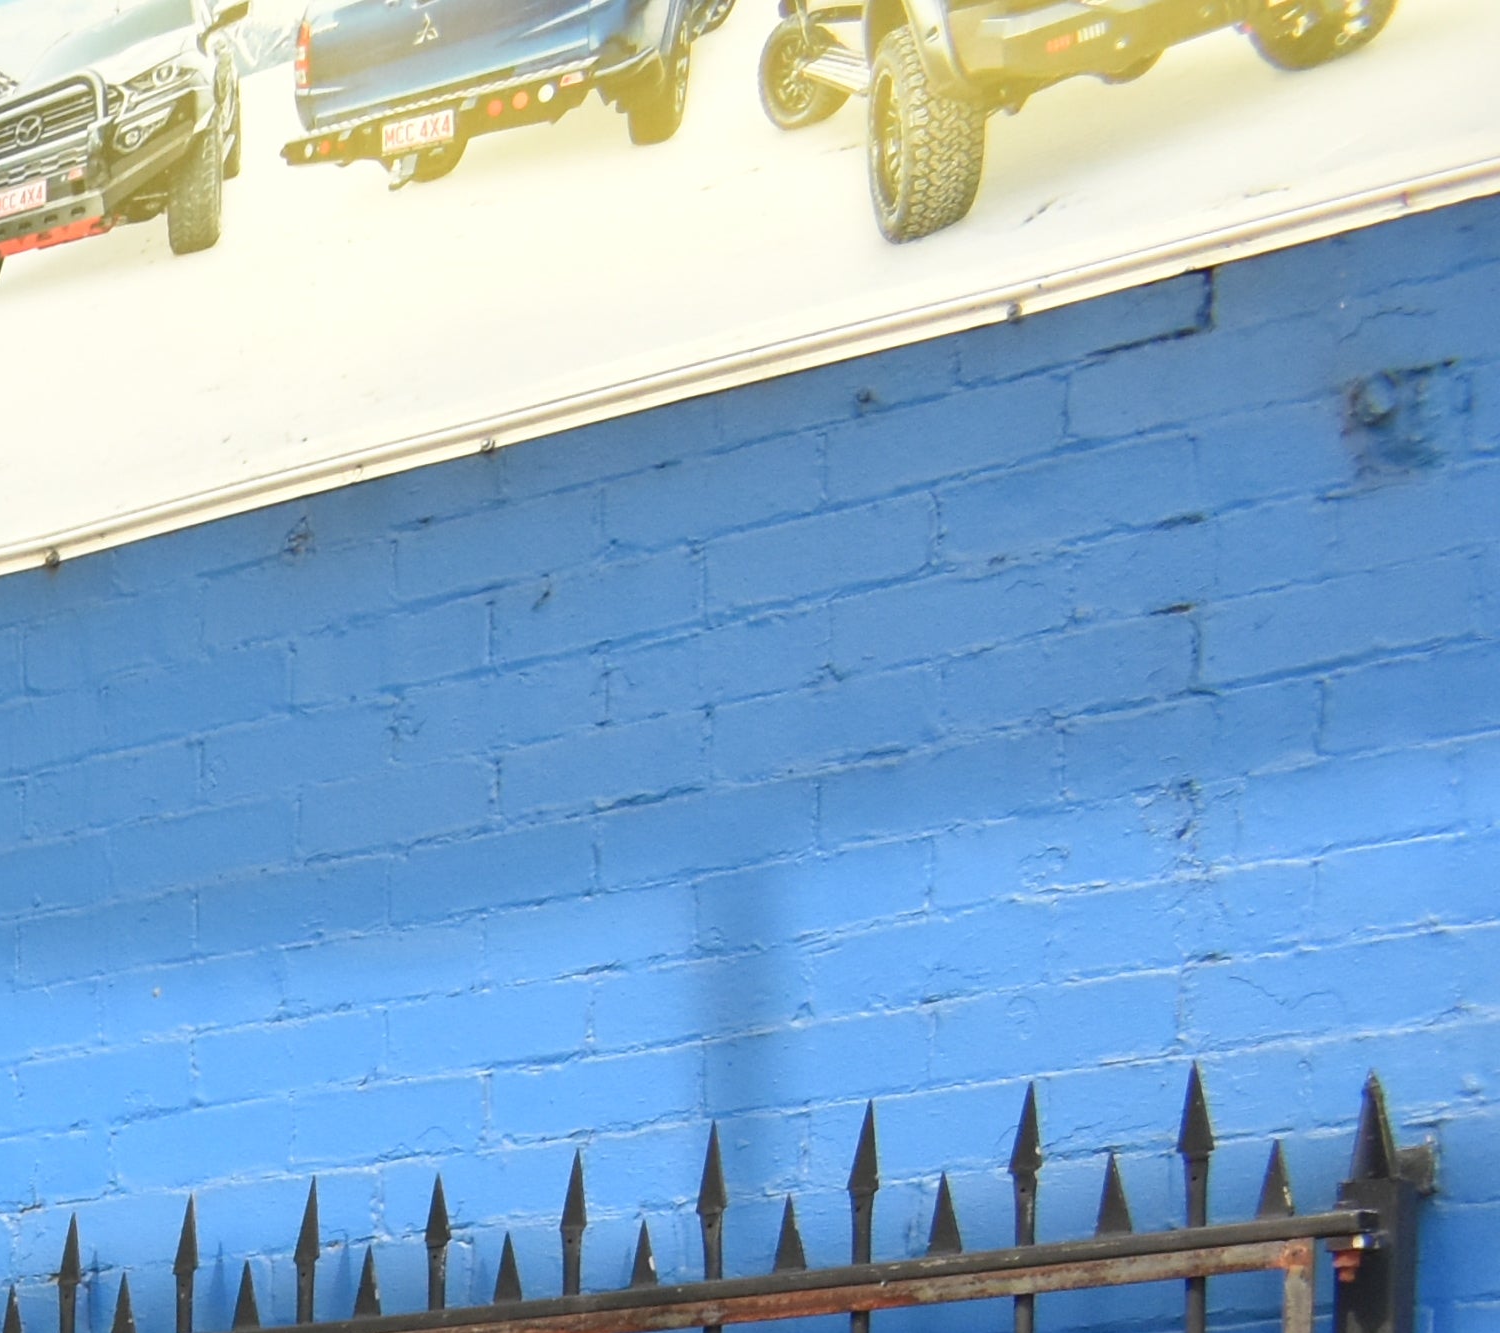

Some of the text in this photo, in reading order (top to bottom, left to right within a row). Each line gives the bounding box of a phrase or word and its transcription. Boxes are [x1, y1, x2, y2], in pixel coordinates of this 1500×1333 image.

[385, 113, 451, 147] MCC 4X4
[19, 184, 43, 204] 4X4
